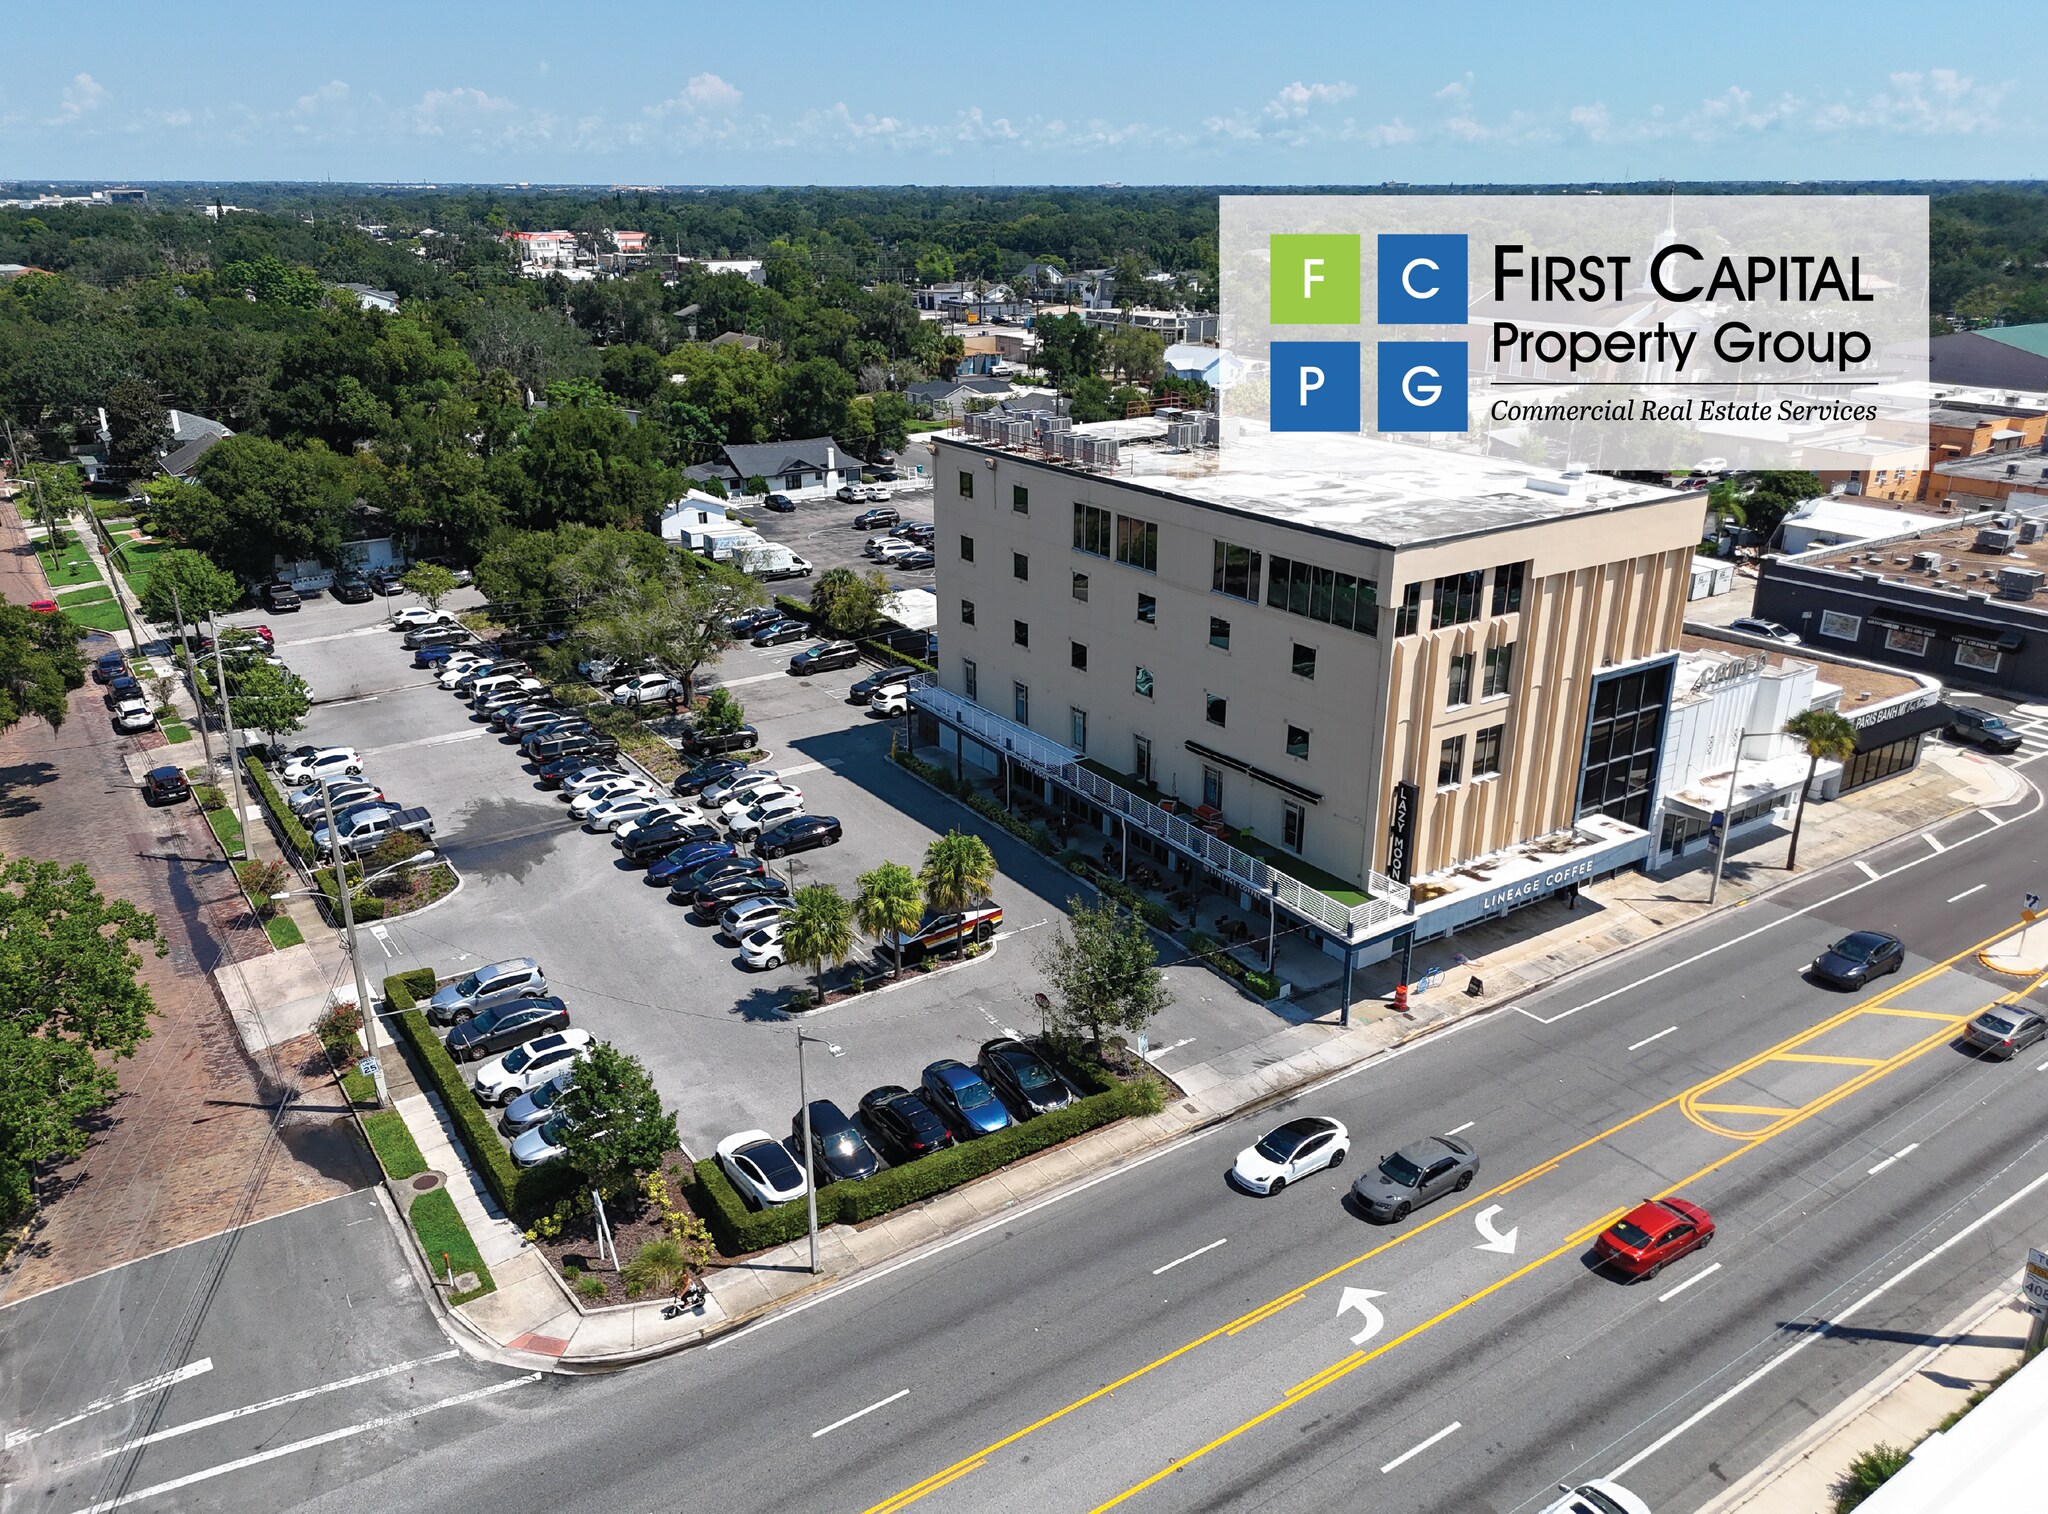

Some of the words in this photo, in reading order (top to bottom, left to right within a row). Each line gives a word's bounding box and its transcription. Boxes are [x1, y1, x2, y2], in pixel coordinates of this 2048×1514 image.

[1699, 650, 1767, 687] CAMEO
[1855, 711, 1878, 731] PARIS
[1397, 787, 1407, 833] LAZY
[1392, 836, 1404, 880] MOON
[1210, 868, 1237, 887] LINEAGE
[1483, 879, 1540, 909] LINEAGE
[1545, 860, 1593, 887] COFFEE
[363, 1064, 378, 1074] 25
[2038, 1254, 2048, 1266] T
[2025, 1282, 2048, 1301] 408
